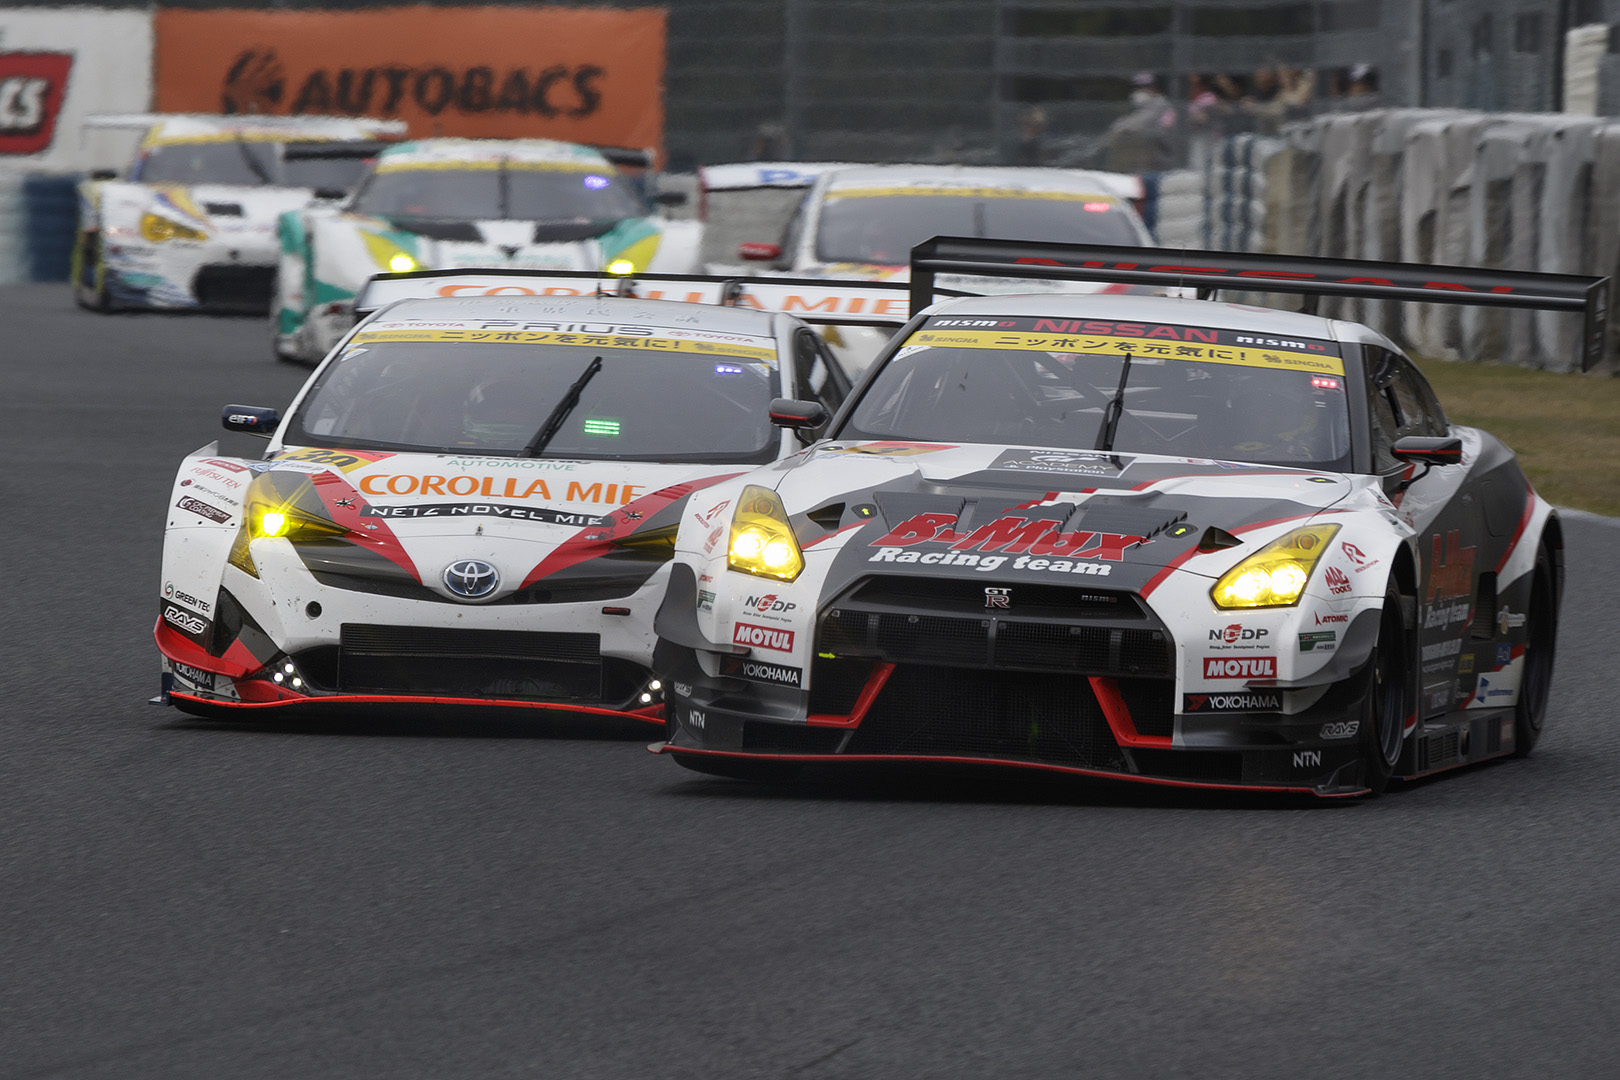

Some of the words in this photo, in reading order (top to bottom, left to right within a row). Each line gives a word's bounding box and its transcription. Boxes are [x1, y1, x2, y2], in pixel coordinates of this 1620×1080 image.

[291, 64, 604, 117] AUTOBACS
[480, 321, 653, 337] PRIUS
[933, 319, 1017, 328] nismo
[1032, 319, 1219, 343] NISSAN
[1236, 335, 1326, 351] nismo
[934, 336, 979, 344] SINGHA
[1283, 358, 1334, 370] SINGHA
[447, 459, 576, 471] AUTOMOTIVE
[1003, 459, 1115, 470] ACADEMY
[221, 476, 243, 488] TEN
[359, 474, 552, 500] COROLLA
[450, 505, 544, 521] NOVEL
[555, 513, 604, 526] MIE
[868, 511, 1157, 562] B-Max
[868, 546, 1009, 572] Racing
[1012, 555, 1113, 576] team
[174, 590, 197, 607] GREEN
[984, 587, 1012, 595] GT
[984, 594, 1011, 608] R
[164, 606, 206, 633] RAYS
[1321, 614, 1349, 624] ATOMIC
[735, 625, 791, 650] MOTUL
[742, 662, 799, 685] YOKOHAMA
[1206, 659, 1274, 677] MOTUL
[1208, 695, 1279, 709] YOKOHAMA
[689, 710, 706, 730] NTN
[1320, 721, 1360, 737] RAYS
[1293, 750, 1321, 769] NTN
